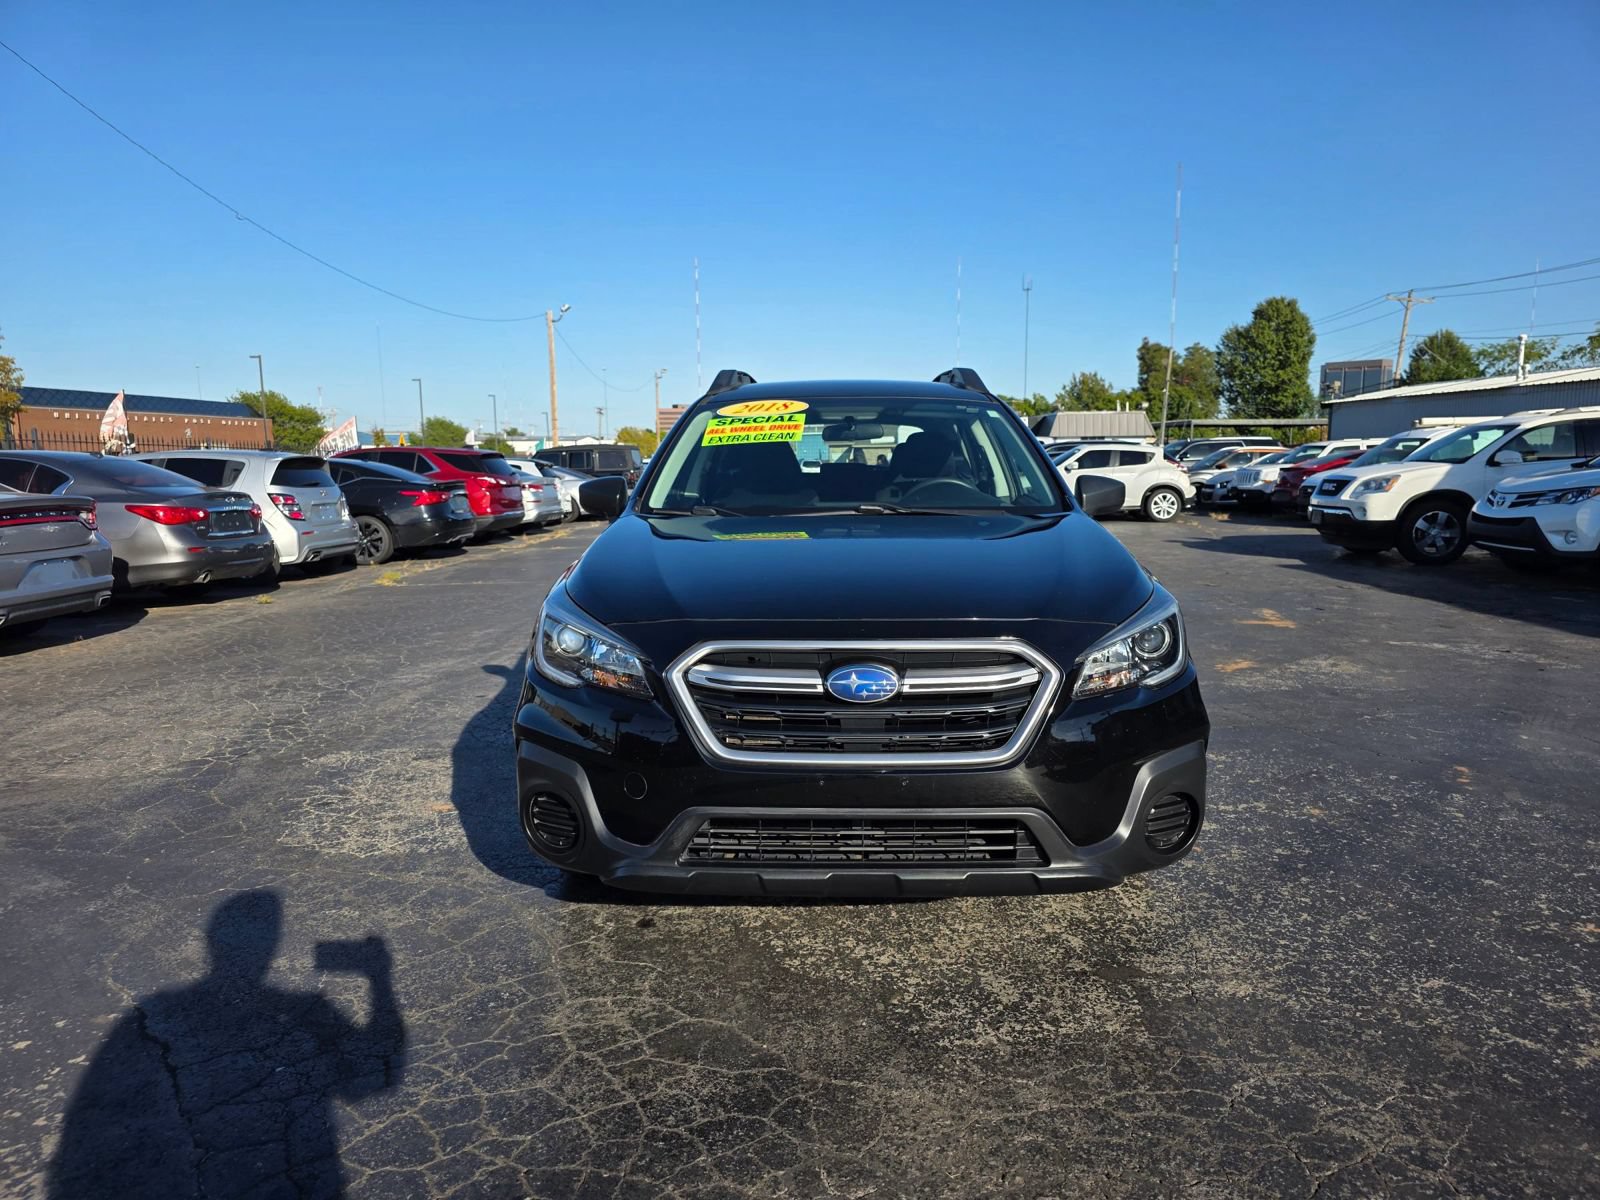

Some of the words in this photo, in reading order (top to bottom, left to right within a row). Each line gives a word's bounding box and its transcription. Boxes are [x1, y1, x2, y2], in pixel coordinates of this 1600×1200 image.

[732, 402, 795, 414] 2018
[127, 414, 174, 423] TATES
[715, 414, 798, 426] SPECIAL
[706, 427, 728, 435] ALL
[730, 425, 766, 434] WHEEL
[769, 424, 802, 432] DRIVE
[707, 434, 750, 444] EXTRA
[753, 432, 796, 441] CLEAN
